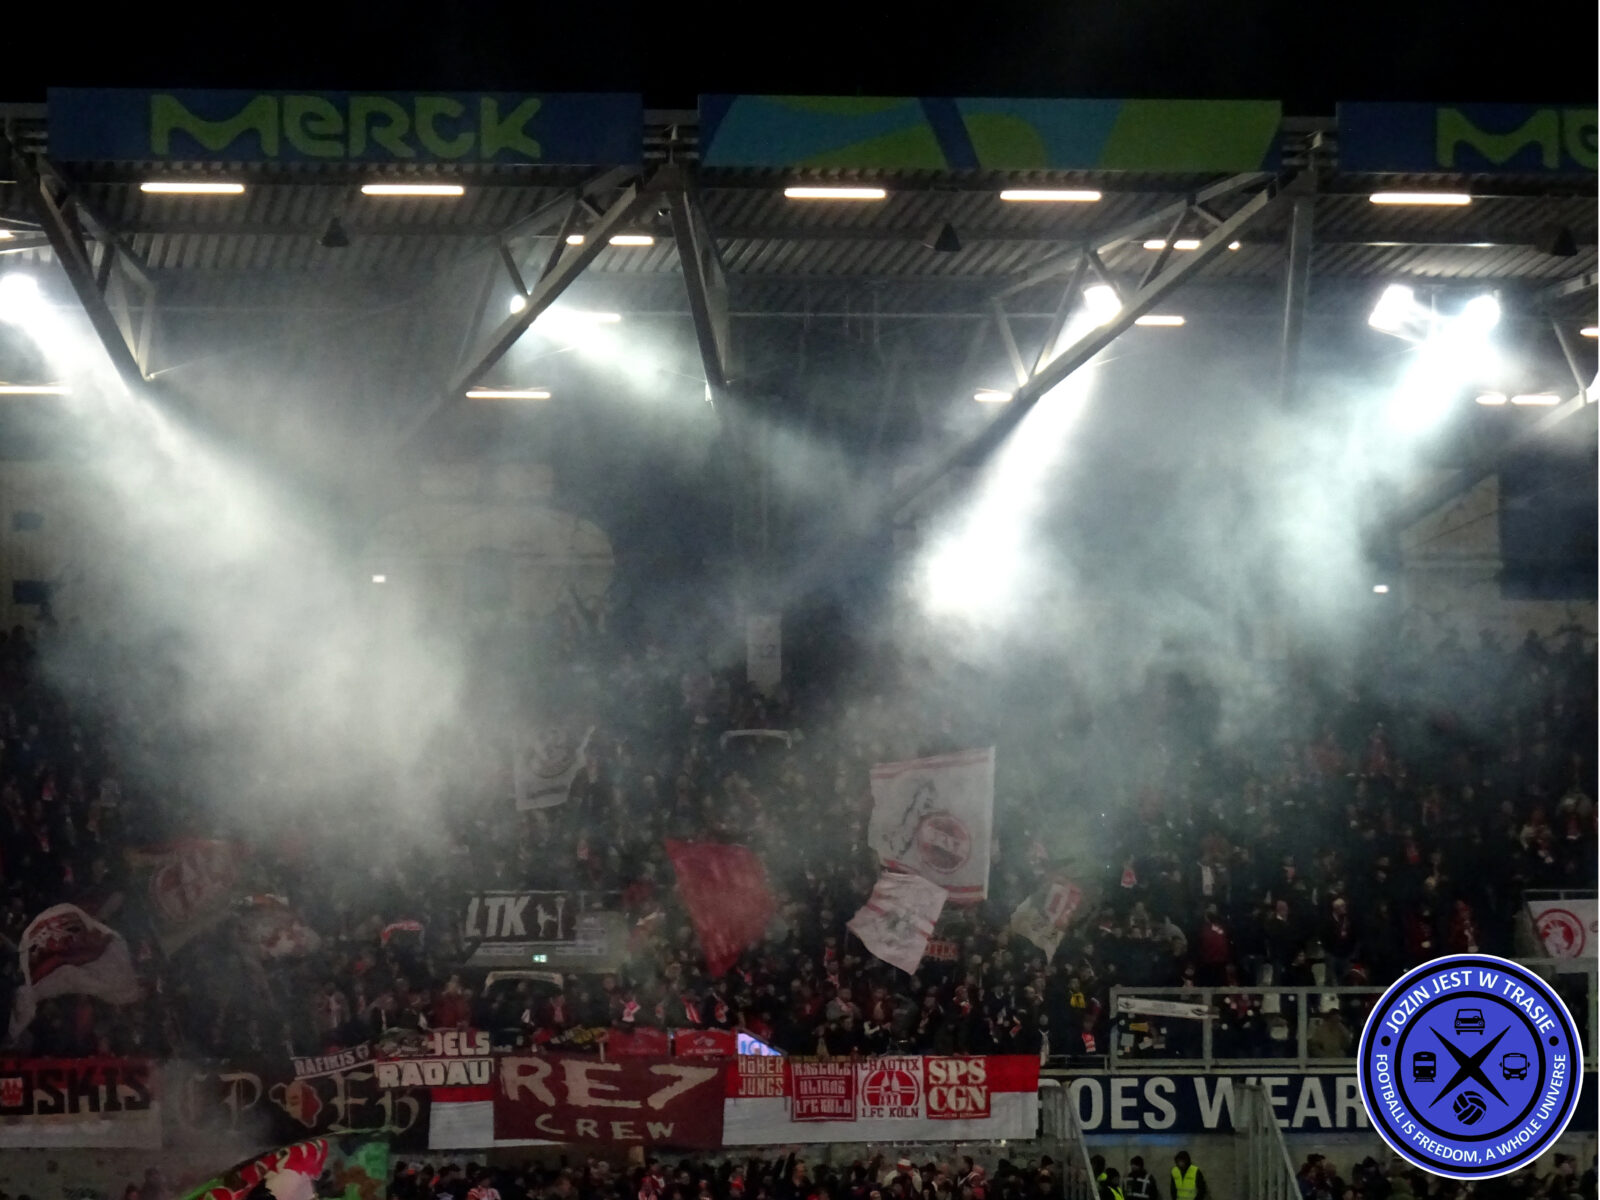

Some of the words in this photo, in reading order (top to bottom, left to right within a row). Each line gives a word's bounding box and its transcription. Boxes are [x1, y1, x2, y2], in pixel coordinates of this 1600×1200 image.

[465, 896, 530, 937] LTK
[378, 1060, 490, 1088] RADAU
[860, 1059, 920, 1071] CHAOTIX
[928, 1059, 987, 1085] SPS
[738, 1077, 785, 1096] JUNGS
[928, 1085, 988, 1112] CGN
[888, 1106, 919, 1118] KÖLN
[534, 1113, 675, 1140] CREW
